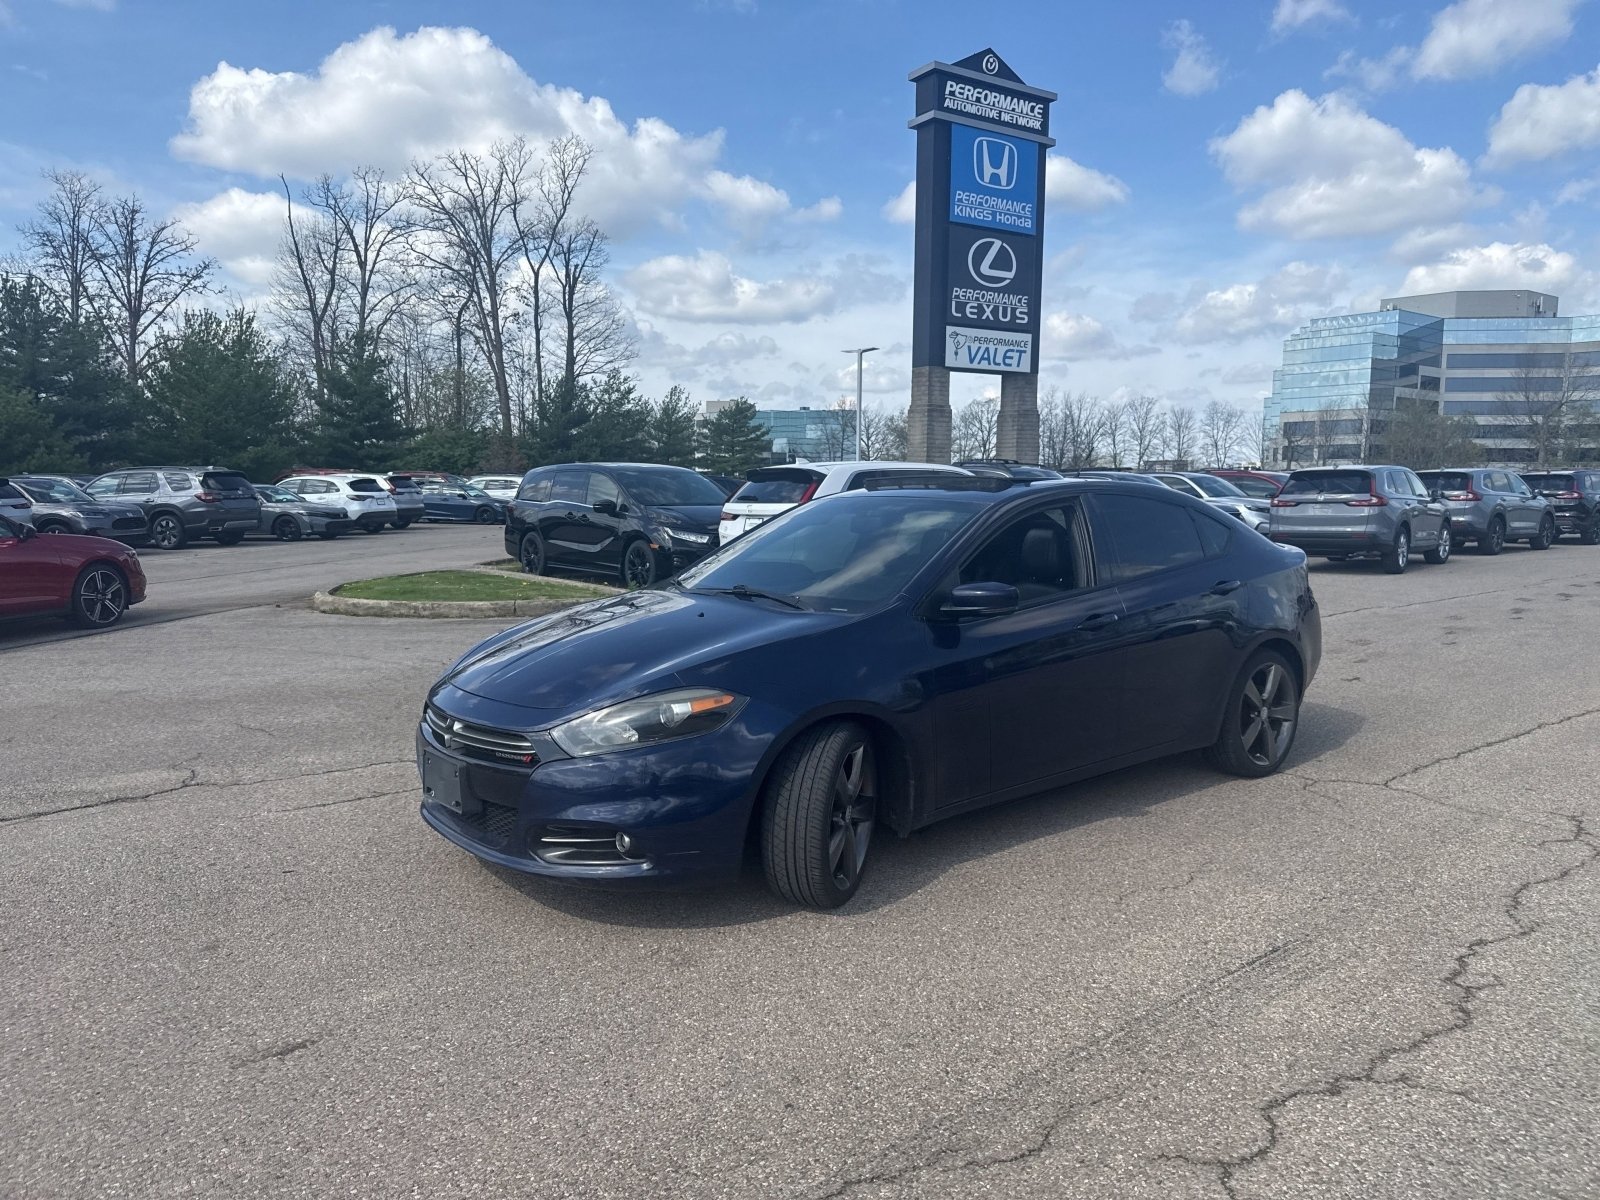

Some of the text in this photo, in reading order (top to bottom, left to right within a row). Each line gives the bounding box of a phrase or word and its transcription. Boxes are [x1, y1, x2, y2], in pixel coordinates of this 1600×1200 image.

[945, 80, 1043, 118] PERFORMANCE
[944, 98, 1042, 131] AUTOMOTIVE NETWORK
[955, 190, 1032, 215] PERFORMANCE
[954, 205, 1032, 228] KINGS Honda
[952, 287, 1028, 307] PERFORMANCE
[952, 300, 1028, 324] LEXUS
[973, 336, 1029, 349] PERFORMANCE
[967, 345, 1027, 368] VALET
